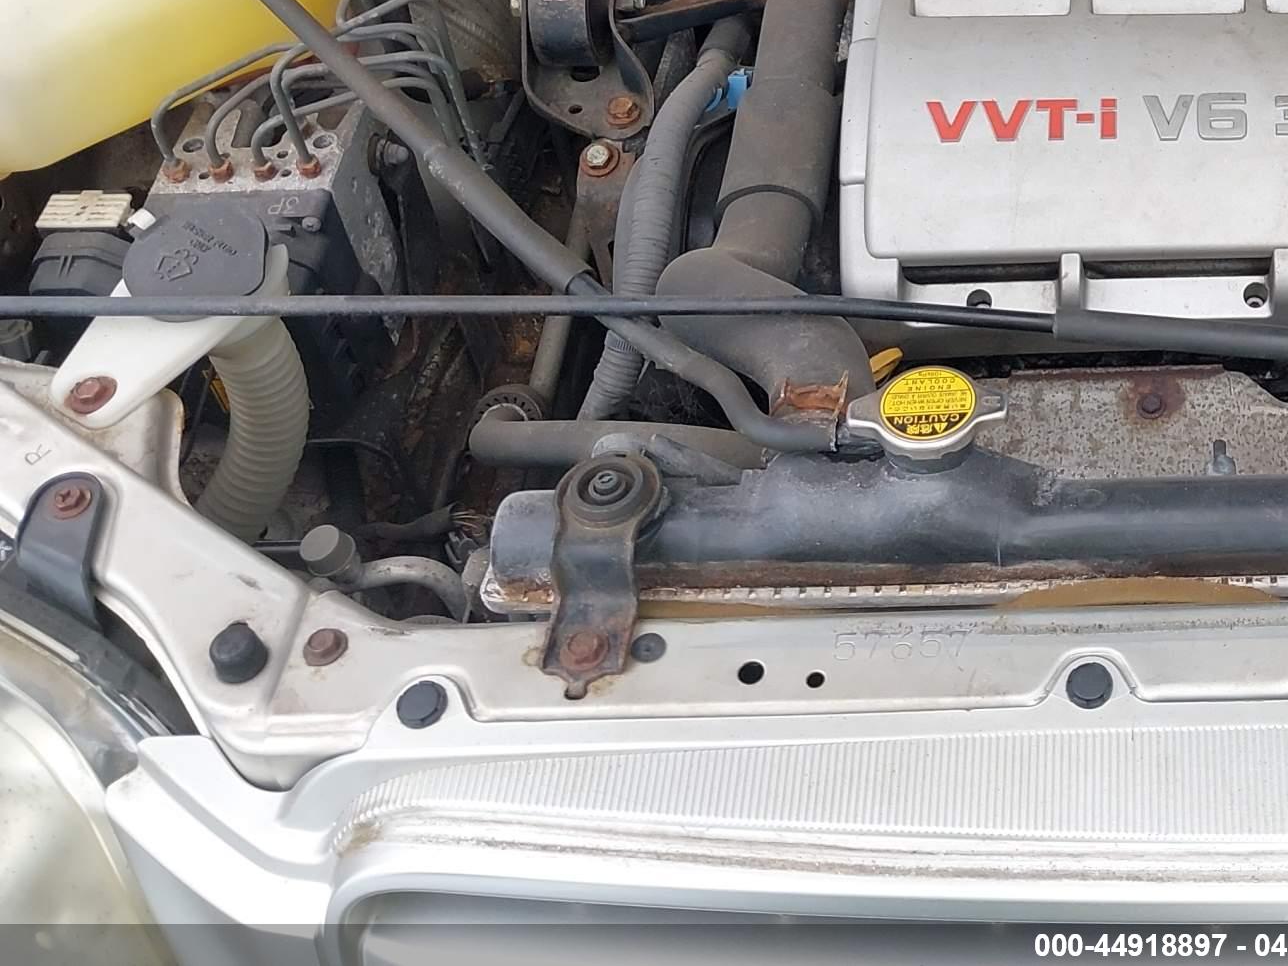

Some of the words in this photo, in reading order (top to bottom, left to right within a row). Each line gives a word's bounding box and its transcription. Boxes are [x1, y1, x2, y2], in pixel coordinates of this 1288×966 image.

[925, 98, 1119, 142] VVT-i
[1143, 94, 1250, 141] V6
[894, 414, 960, 425] CAUTION
